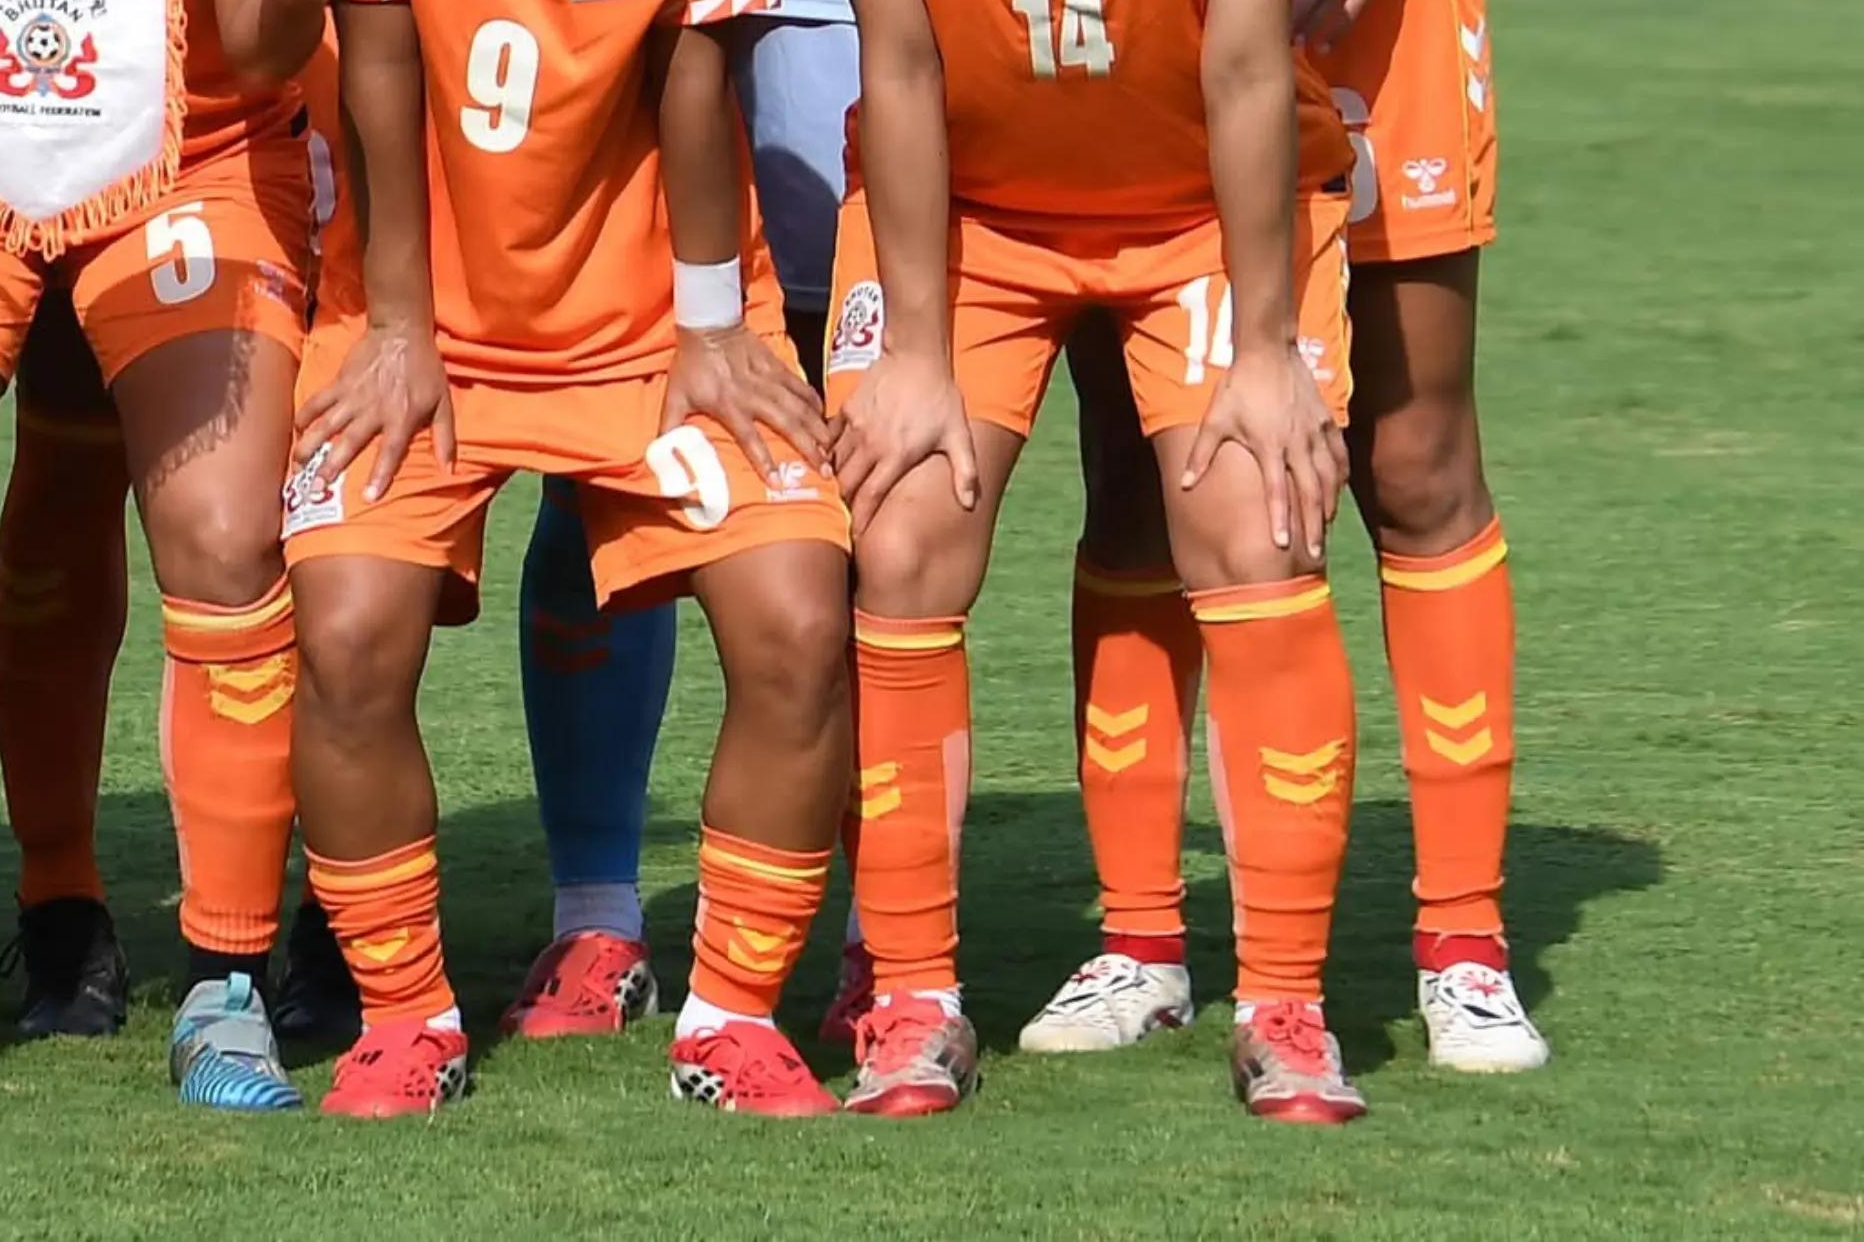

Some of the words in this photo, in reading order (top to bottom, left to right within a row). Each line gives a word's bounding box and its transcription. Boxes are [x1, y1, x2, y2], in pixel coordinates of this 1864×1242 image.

[460, 19, 539, 153] 9
[144, 201, 216, 305] 5
[645, 424, 730, 530] 9
